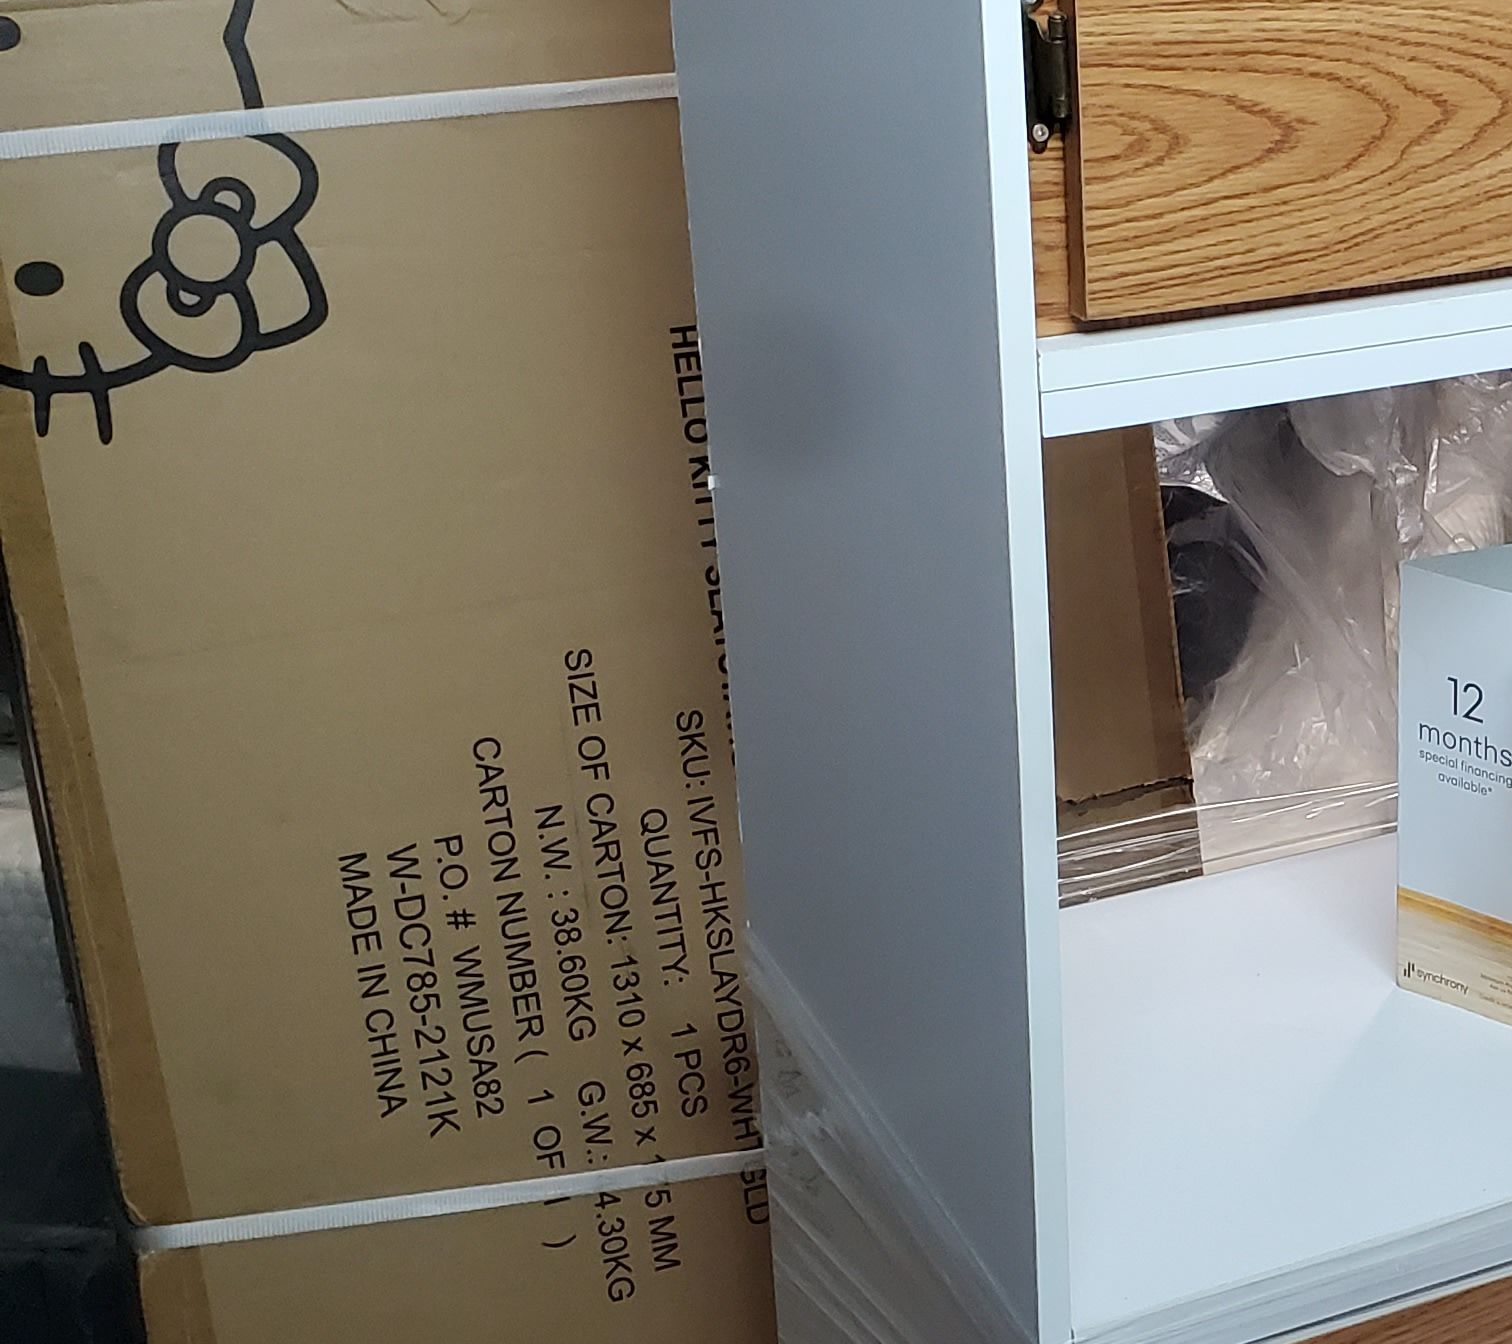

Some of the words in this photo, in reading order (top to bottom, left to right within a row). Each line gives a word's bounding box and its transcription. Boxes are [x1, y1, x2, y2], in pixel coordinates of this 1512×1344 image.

[669, 324, 709, 445] HELLO
[564, 648, 602, 726] SIZE
[1447, 676, 1484, 724] 12
[577, 735, 610, 781] OF
[675, 709, 711, 789] SKU:
[1419, 722, 1512, 767] months
[1419, 749, 1458, 770] special
[1461, 760, 1512, 789] financing
[472, 736, 521, 883] CARTON
[337, 852, 383, 956] MADE
[586, 792, 633, 945] CARTON:
[640, 808, 690, 986] QUANTITY:
[357, 963, 390, 999] IN
[386, 842, 461, 1138] W-DC785-2121K
[434, 834, 469, 901] P.O.
[453, 944, 505, 1118] WMUSA82
[496, 891, 545, 1042] NUMBER
[551, 907, 597, 1042] 38.60KG
[611, 954, 646, 1028] 1310
[1416, 968, 1469, 996] synchrony
[621, 1036, 644, 1056] x
[671, 1022, 698, 1038] 1
[687, 795, 770, 1226] IVFS-HKSLAYDR6-WHTGLD
[365, 1008, 408, 1118] CHINA
[528, 1088, 555, 1104] 1
[626, 1062, 659, 1119] 685
[674, 1048, 708, 1118] PCS
[533, 1124, 566, 1170] OF
[578, 1080, 614, 1164] G.W.:
[635, 1126, 657, 1146] x
[594, 1188, 636, 1303] 4.30KG
[648, 1215, 682, 1272] MM
